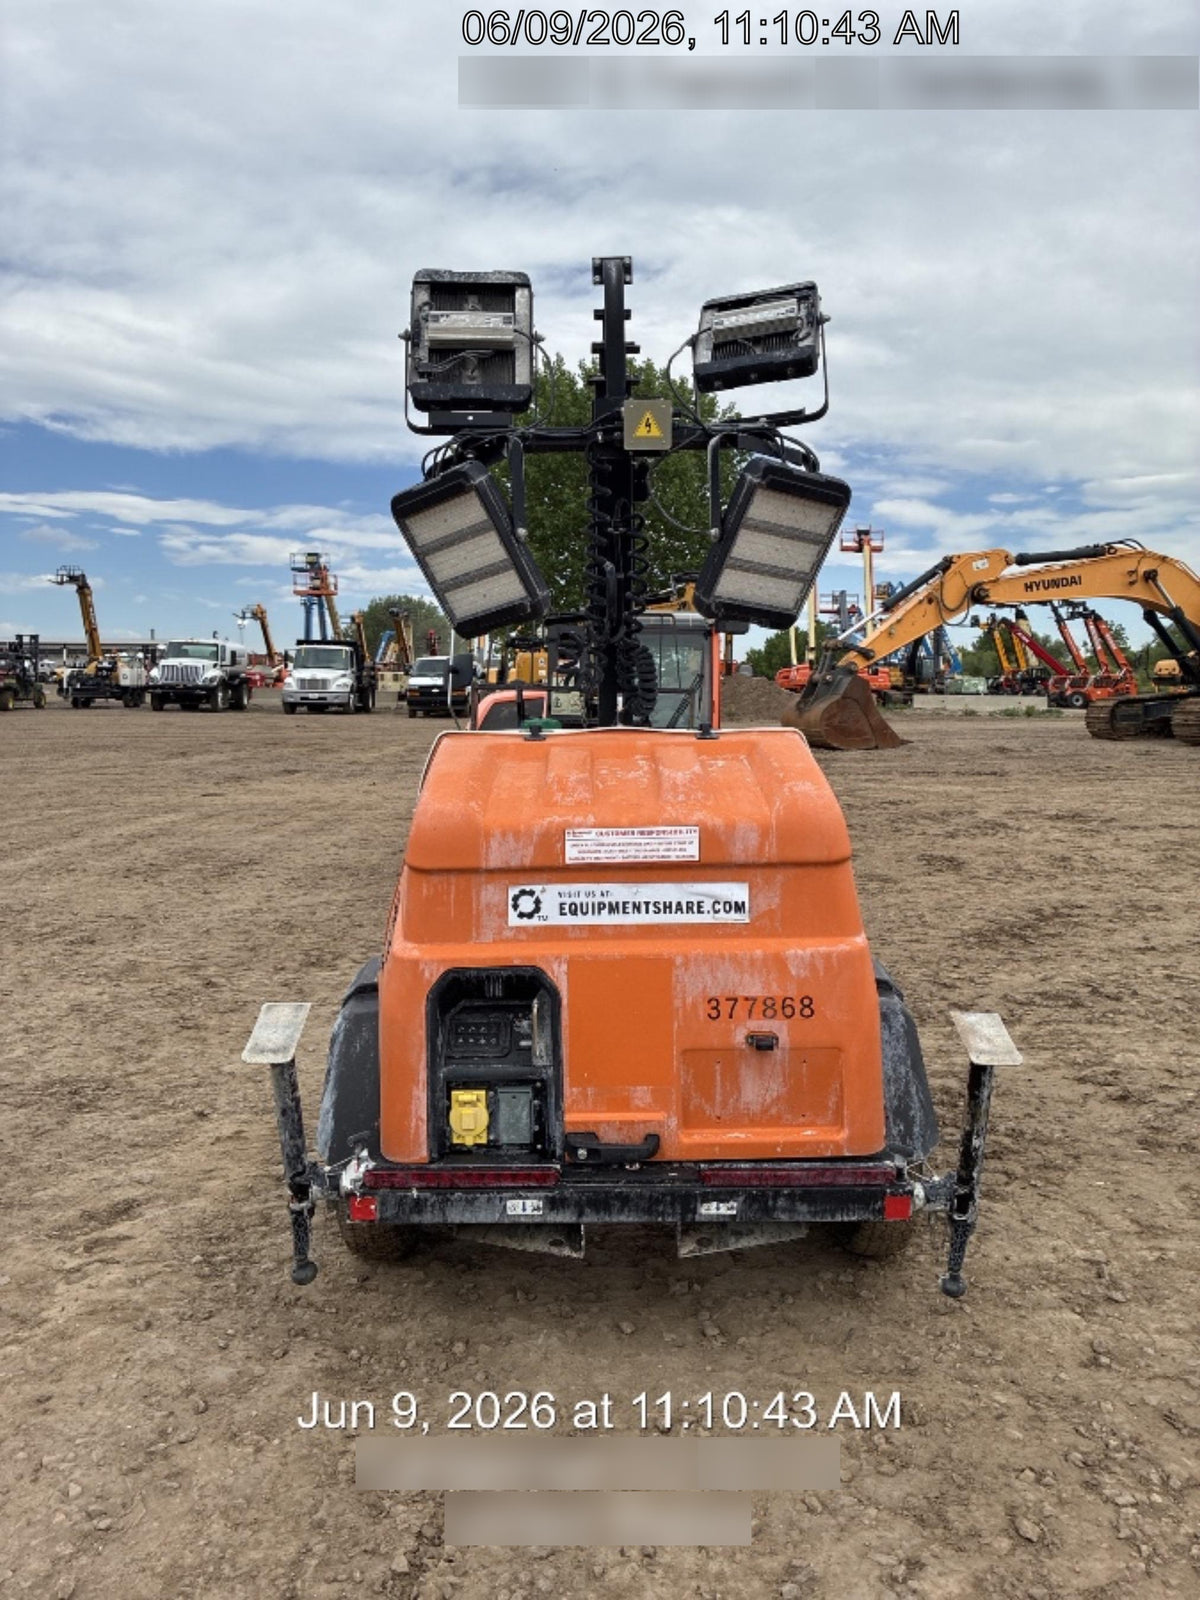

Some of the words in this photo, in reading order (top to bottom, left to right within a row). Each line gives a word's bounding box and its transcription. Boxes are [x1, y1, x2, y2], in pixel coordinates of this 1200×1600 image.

[1024, 574, 1082, 593] HYUNDAI
[558, 890, 582, 899] VISIT
[584, 890, 597, 898] US
[558, 899, 747, 917] EQUIPMENTSHARE.COM
[707, 995, 815, 1021] 377868
